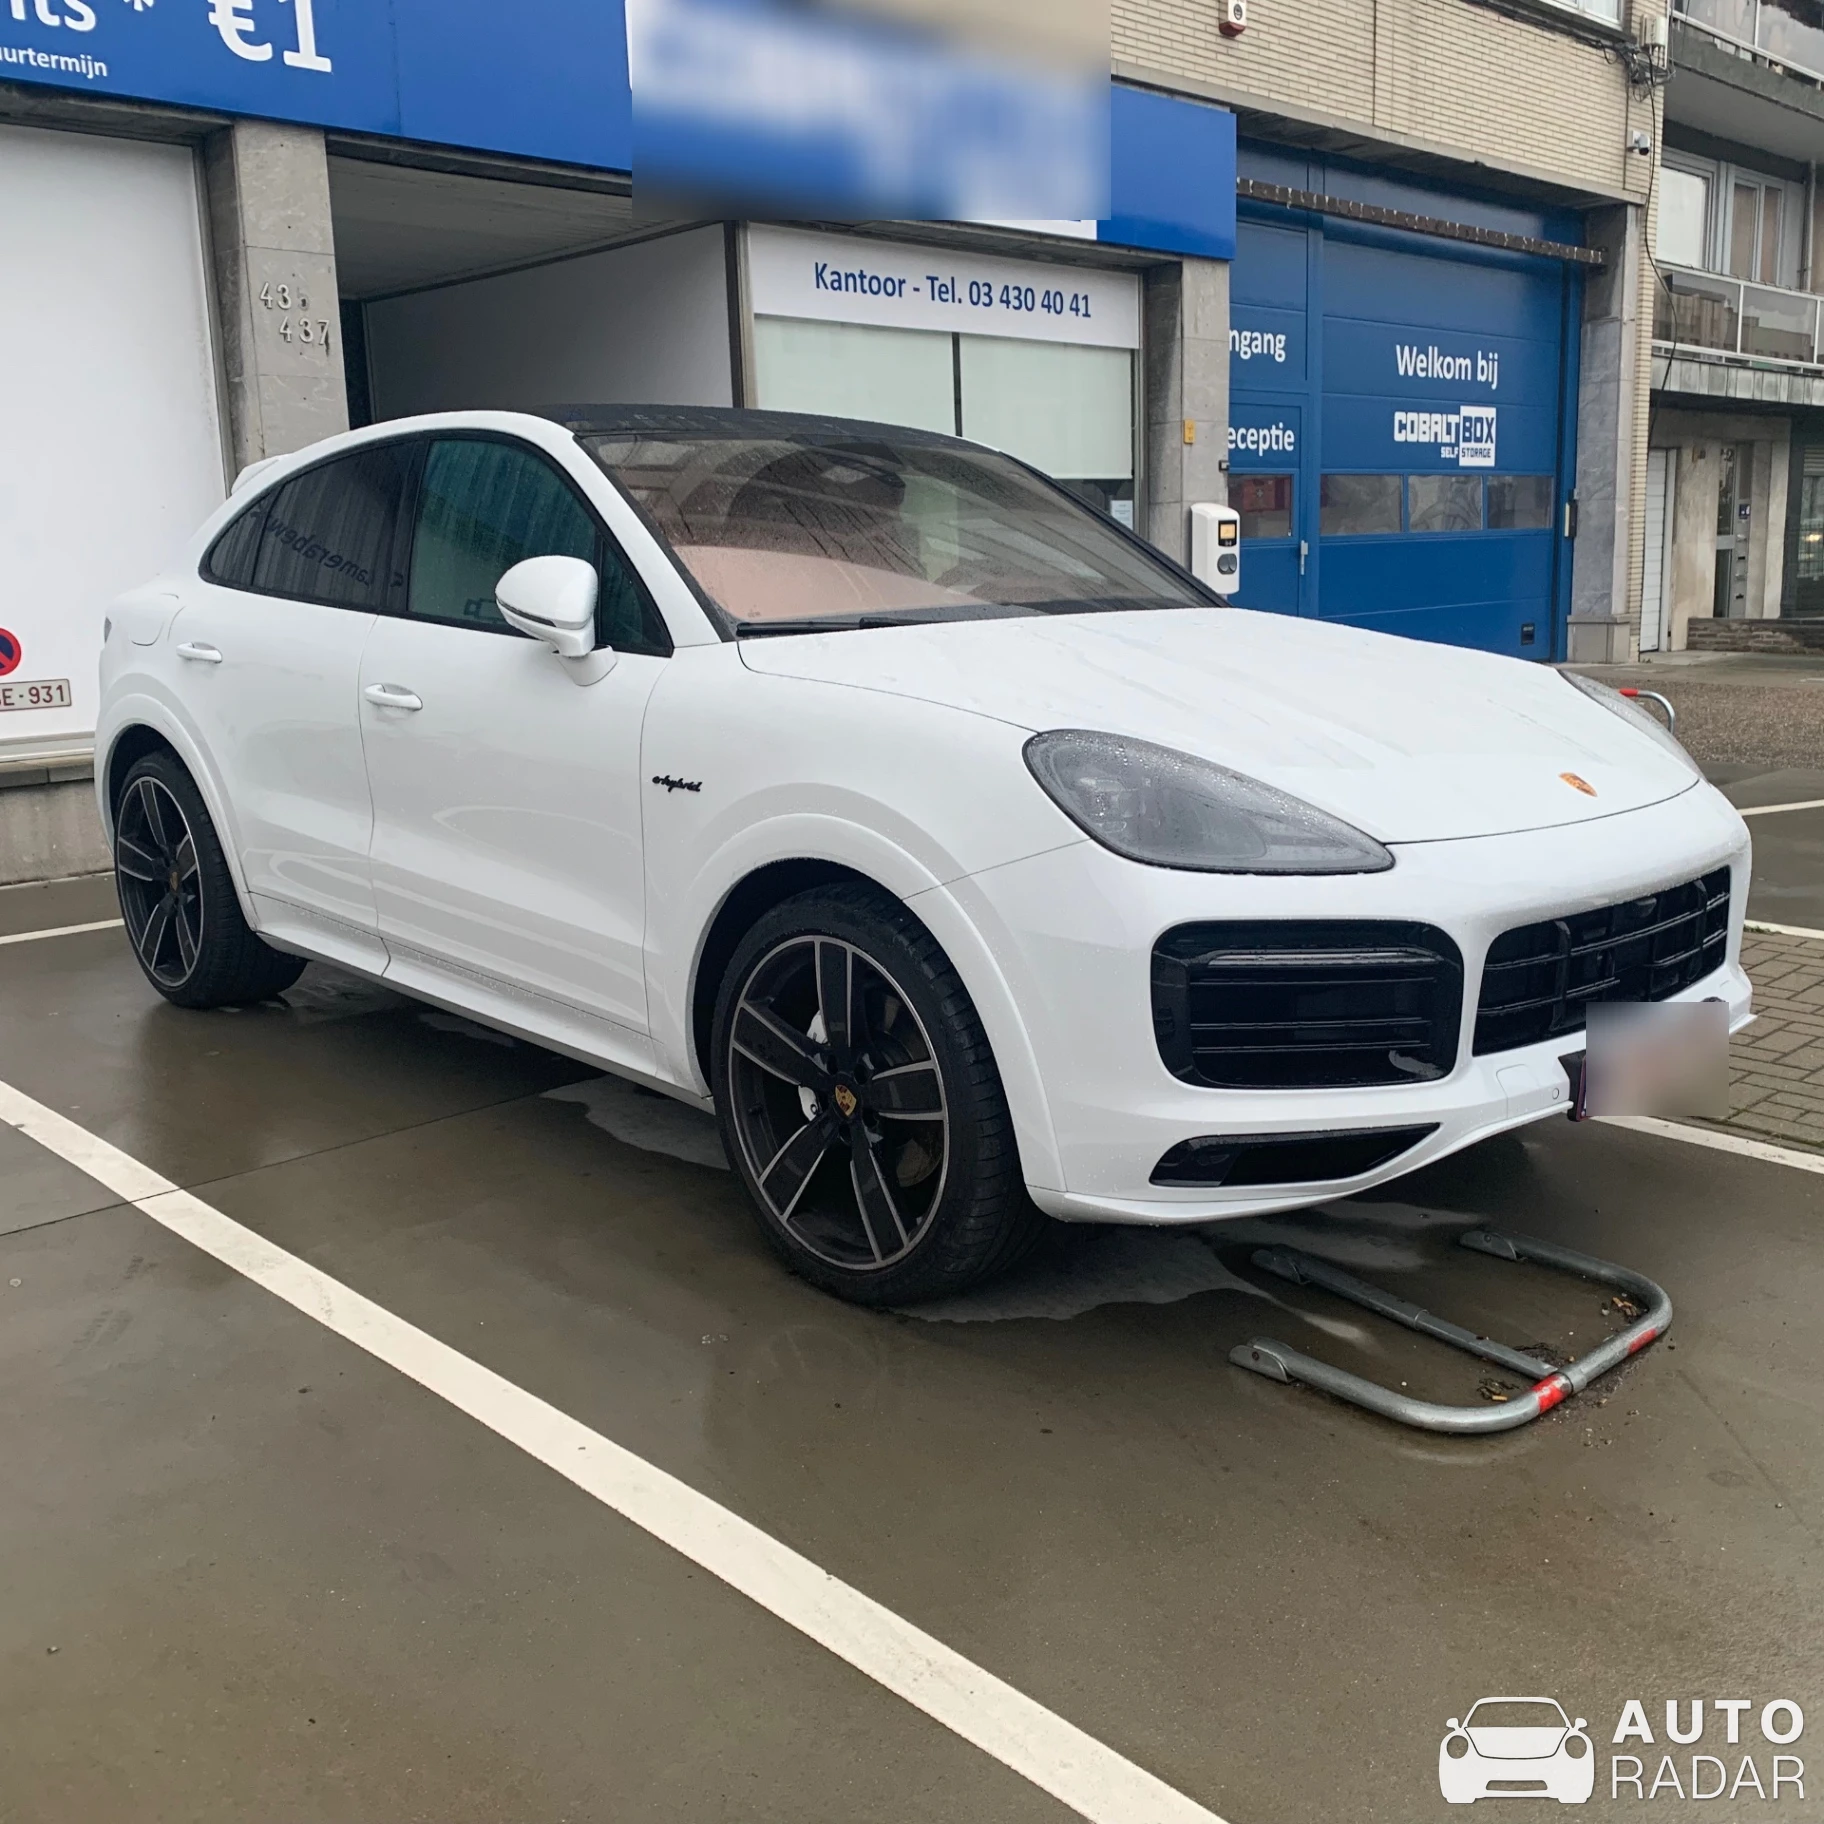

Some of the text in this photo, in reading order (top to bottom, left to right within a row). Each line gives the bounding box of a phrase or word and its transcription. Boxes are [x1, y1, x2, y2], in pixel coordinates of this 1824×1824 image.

[0, 46, 108, 79] urtermijn
[814, 261, 907, 298] Kantoor
[926, 275, 963, 304] Tel.
[968, 280, 993, 308] 03
[999, 284, 1036, 312] 430
[1040, 289, 1064, 315] 40
[1069, 293, 1092, 318] 41
[279, 316, 331, 346] 437
[1229, 329, 1287, 363] ngang
[1395, 344, 1499, 391] Welkom bij
[1228, 422, 1295, 457] eceptie
[1440, 446, 1492, 459] SELF STORAGE
[0, 684, 65, 707] E-931
